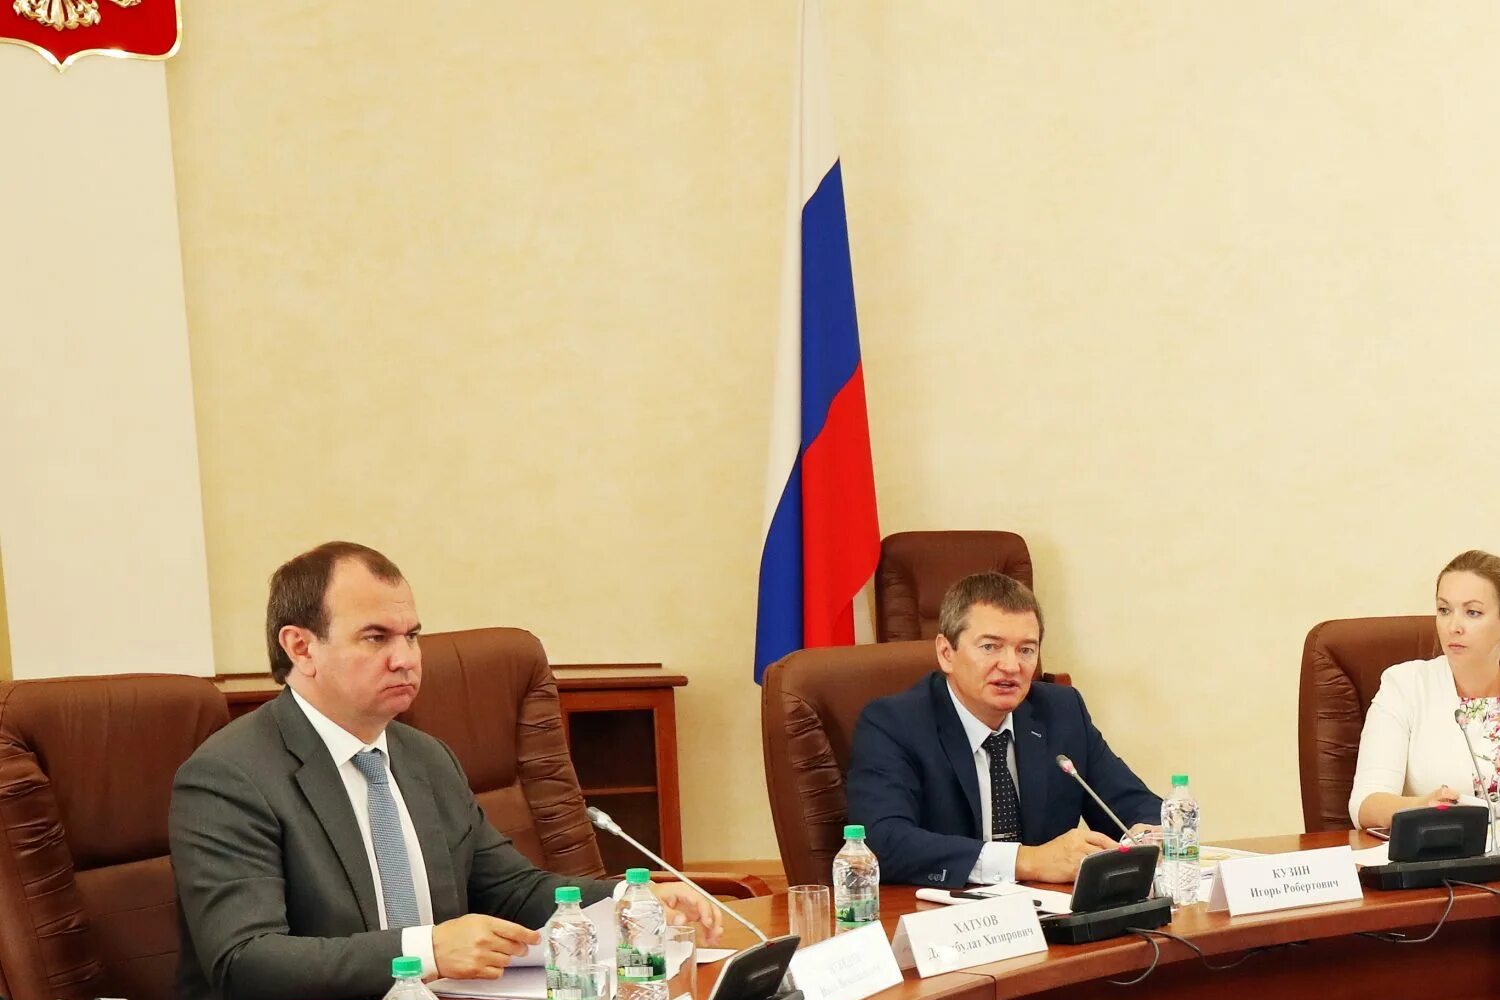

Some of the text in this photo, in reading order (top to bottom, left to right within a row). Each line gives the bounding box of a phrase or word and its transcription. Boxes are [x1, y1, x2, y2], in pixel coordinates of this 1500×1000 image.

[1272, 864, 1311, 879] КУЗИН
[1250, 879, 1339, 899] Игорь Робертович
[982, 926, 1034, 947] Хизирович
